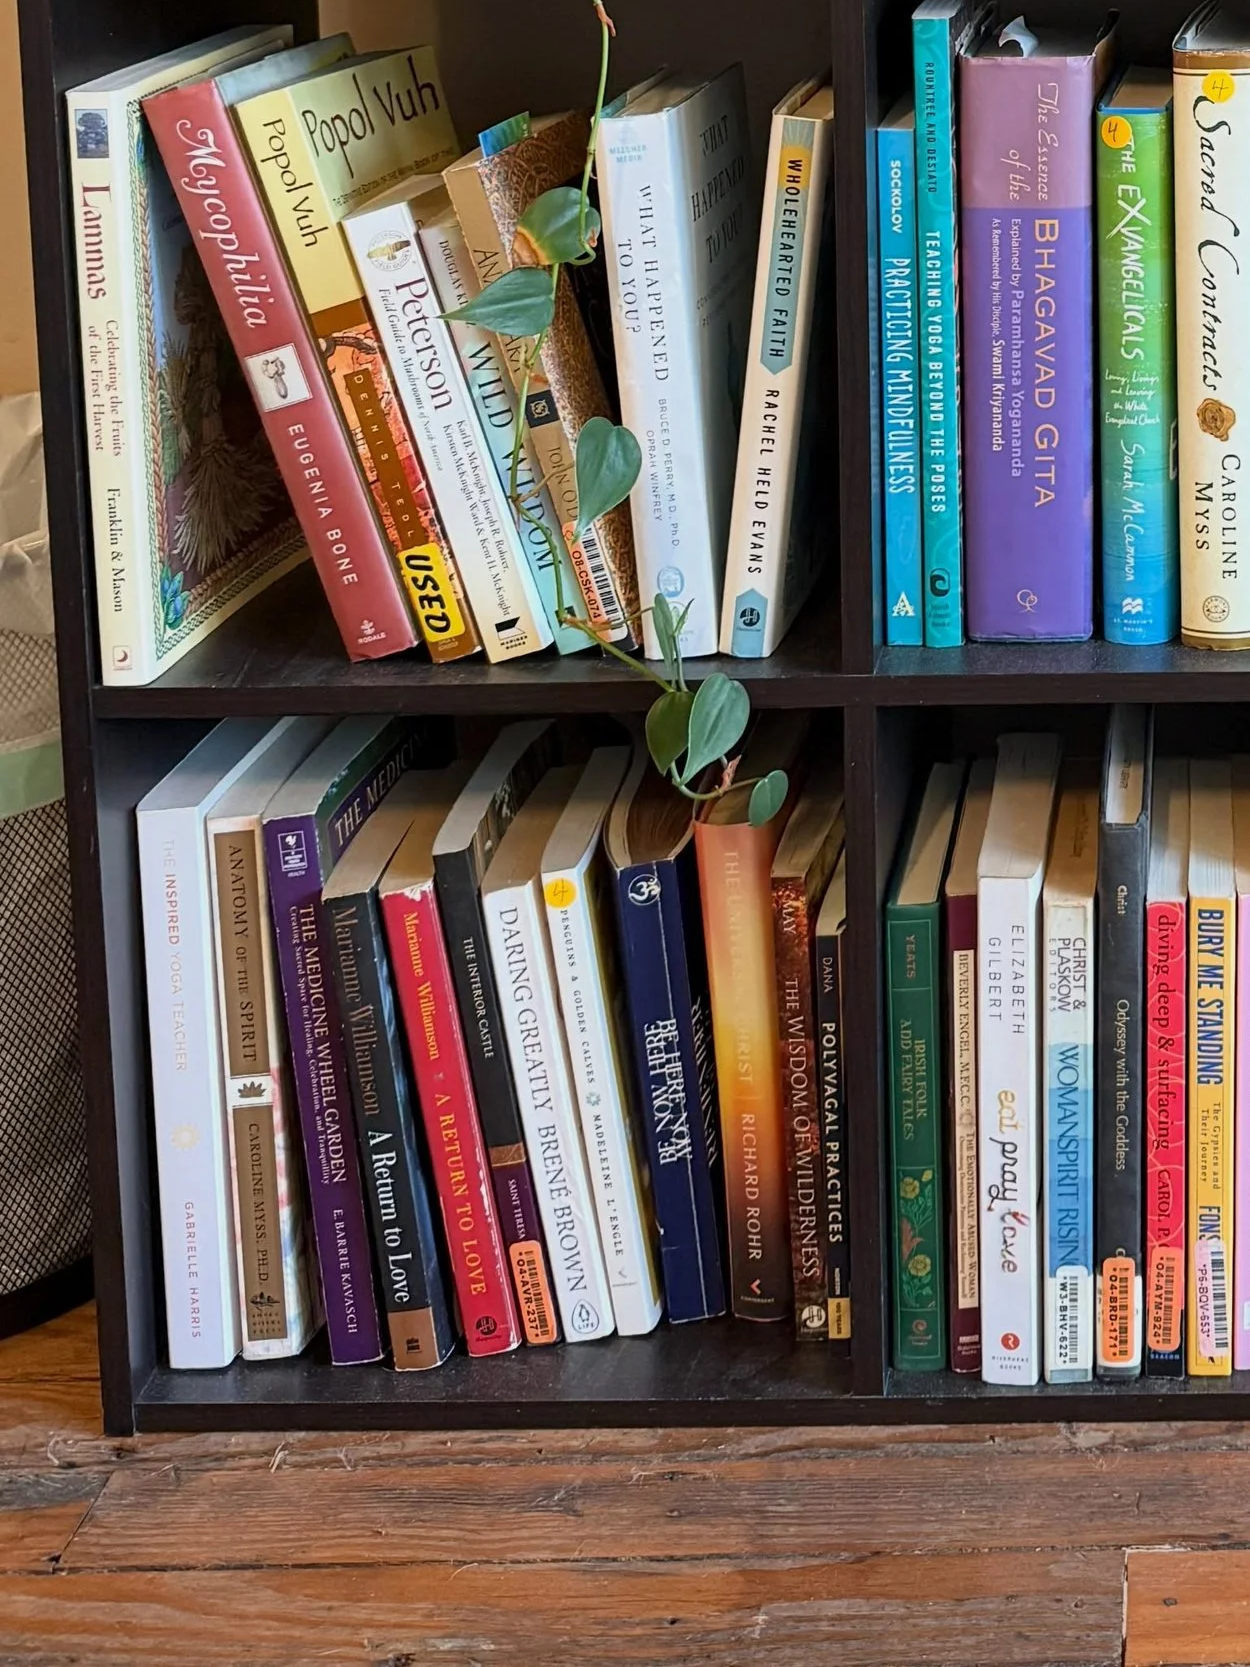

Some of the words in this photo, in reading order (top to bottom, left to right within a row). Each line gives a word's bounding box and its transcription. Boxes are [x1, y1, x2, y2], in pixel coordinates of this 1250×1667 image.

[261, 118, 300, 195] Popol
[292, 197, 329, 248] Vuh
[1192, 95, 1233, 214] Sacred
[82, 181, 112, 301] Lammas
[771, 158, 802, 296] WHOLEHEARTED
[175, 118, 269, 329] Mycophilia
[288, 422, 333, 520] EUGENIA
[328, 528, 358, 586] BONE
[394, 275, 452, 411] Peterson
[770, 307, 786, 359] FAITH
[885, 258, 912, 367] PRACTICING
[1034, 217, 1058, 411] BHAGAVAD
[1198, 232, 1238, 393] Contracts
[758, 389, 779, 456] RACHEL
[887, 370, 916, 495] MINDFULNESS
[1034, 422, 1057, 509] GITA
[756, 464, 769, 514] HELD
[1195, 481, 1211, 552] MYSS
[1219, 453, 1237, 581] CAROLINE
[747, 519, 764, 576] EVANS
[405, 553, 451, 635] USED
[1196, 908, 1221, 950] BURY
[1198, 961, 1221, 986] ME
[989, 938, 1001, 1021] GILBERT
[1012, 924, 1025, 1035] ELIZABETH
[1196, 994, 1223, 1086] STANDING
[500, 906, 534, 1009] DARING
[519, 1012, 552, 1111] GREATLY
[537, 1124, 569, 1200] BRENÉ
[554, 1205, 587, 1293] BROWN
[997, 1088, 1017, 1133] eat
[988, 1139, 1017, 1212] pray
[1000, 1208, 1026, 1275] love
